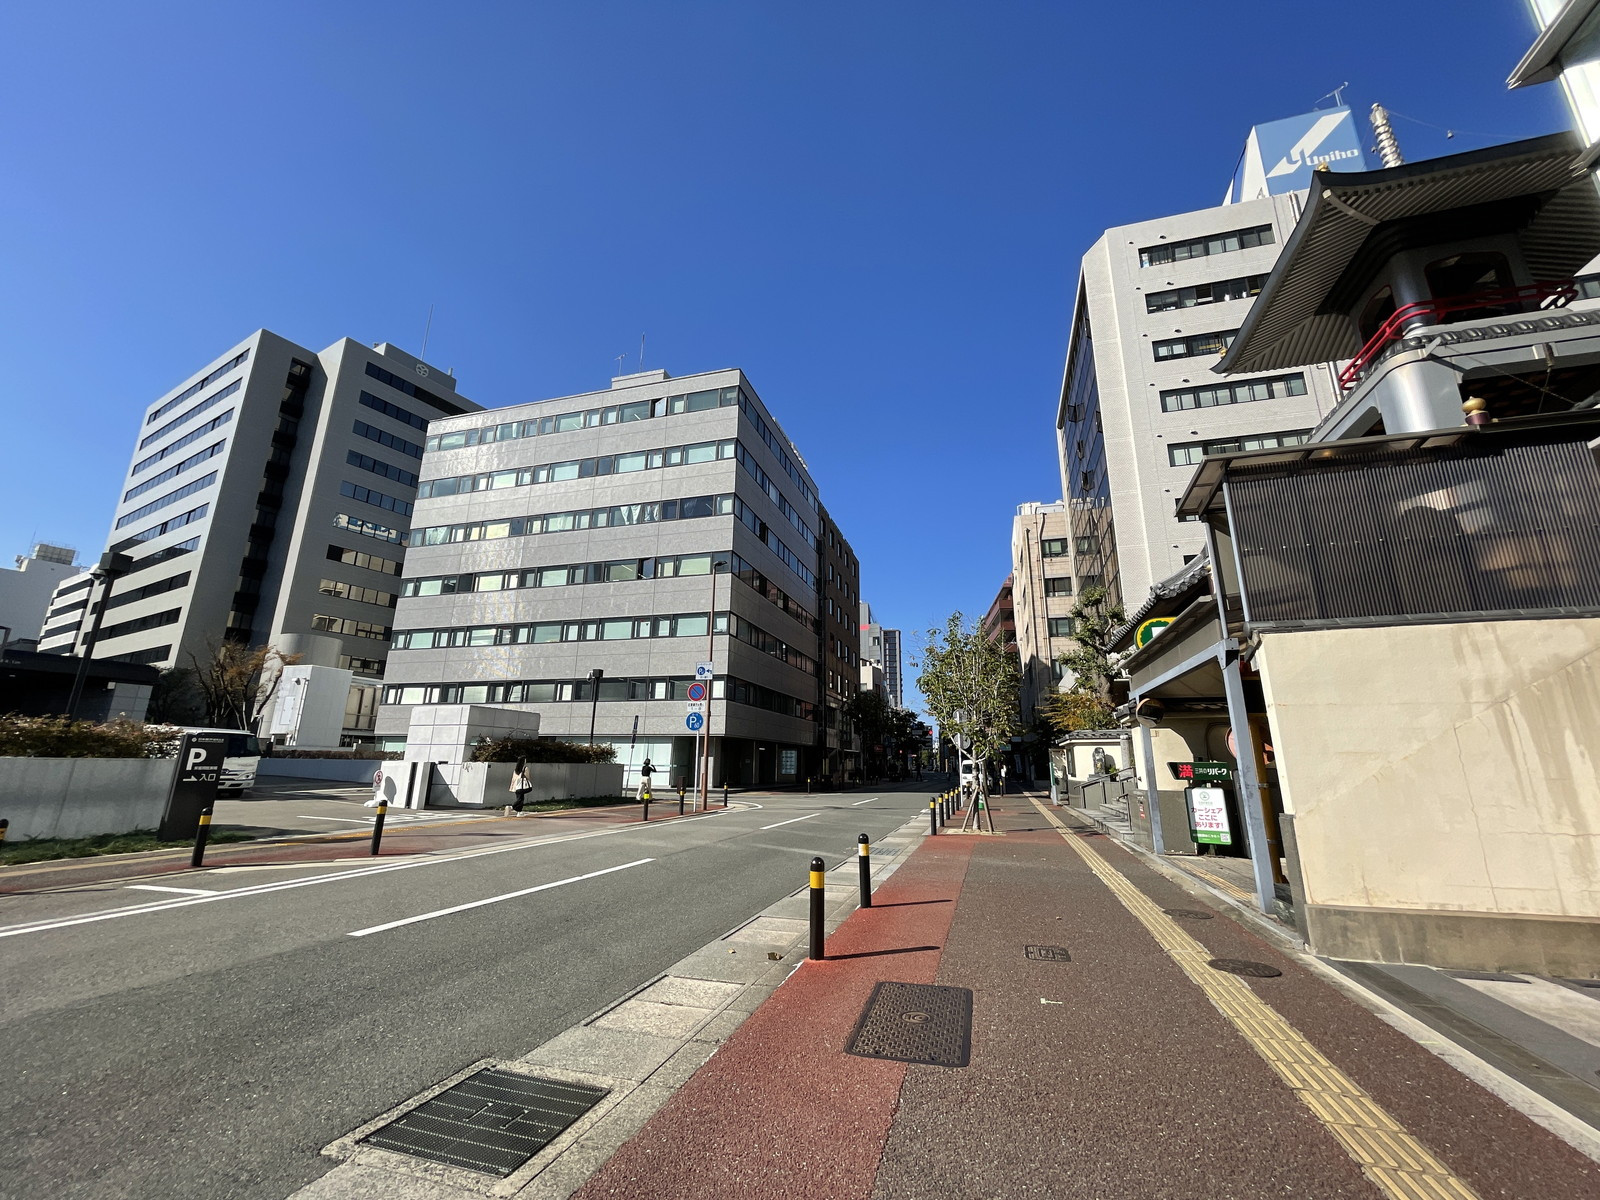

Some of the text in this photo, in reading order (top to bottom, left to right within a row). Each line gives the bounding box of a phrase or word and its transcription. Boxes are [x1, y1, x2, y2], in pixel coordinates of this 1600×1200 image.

[690, 717, 697, 728] P
[186, 748, 207, 770] P
[1179, 764, 1194, 778] 満
